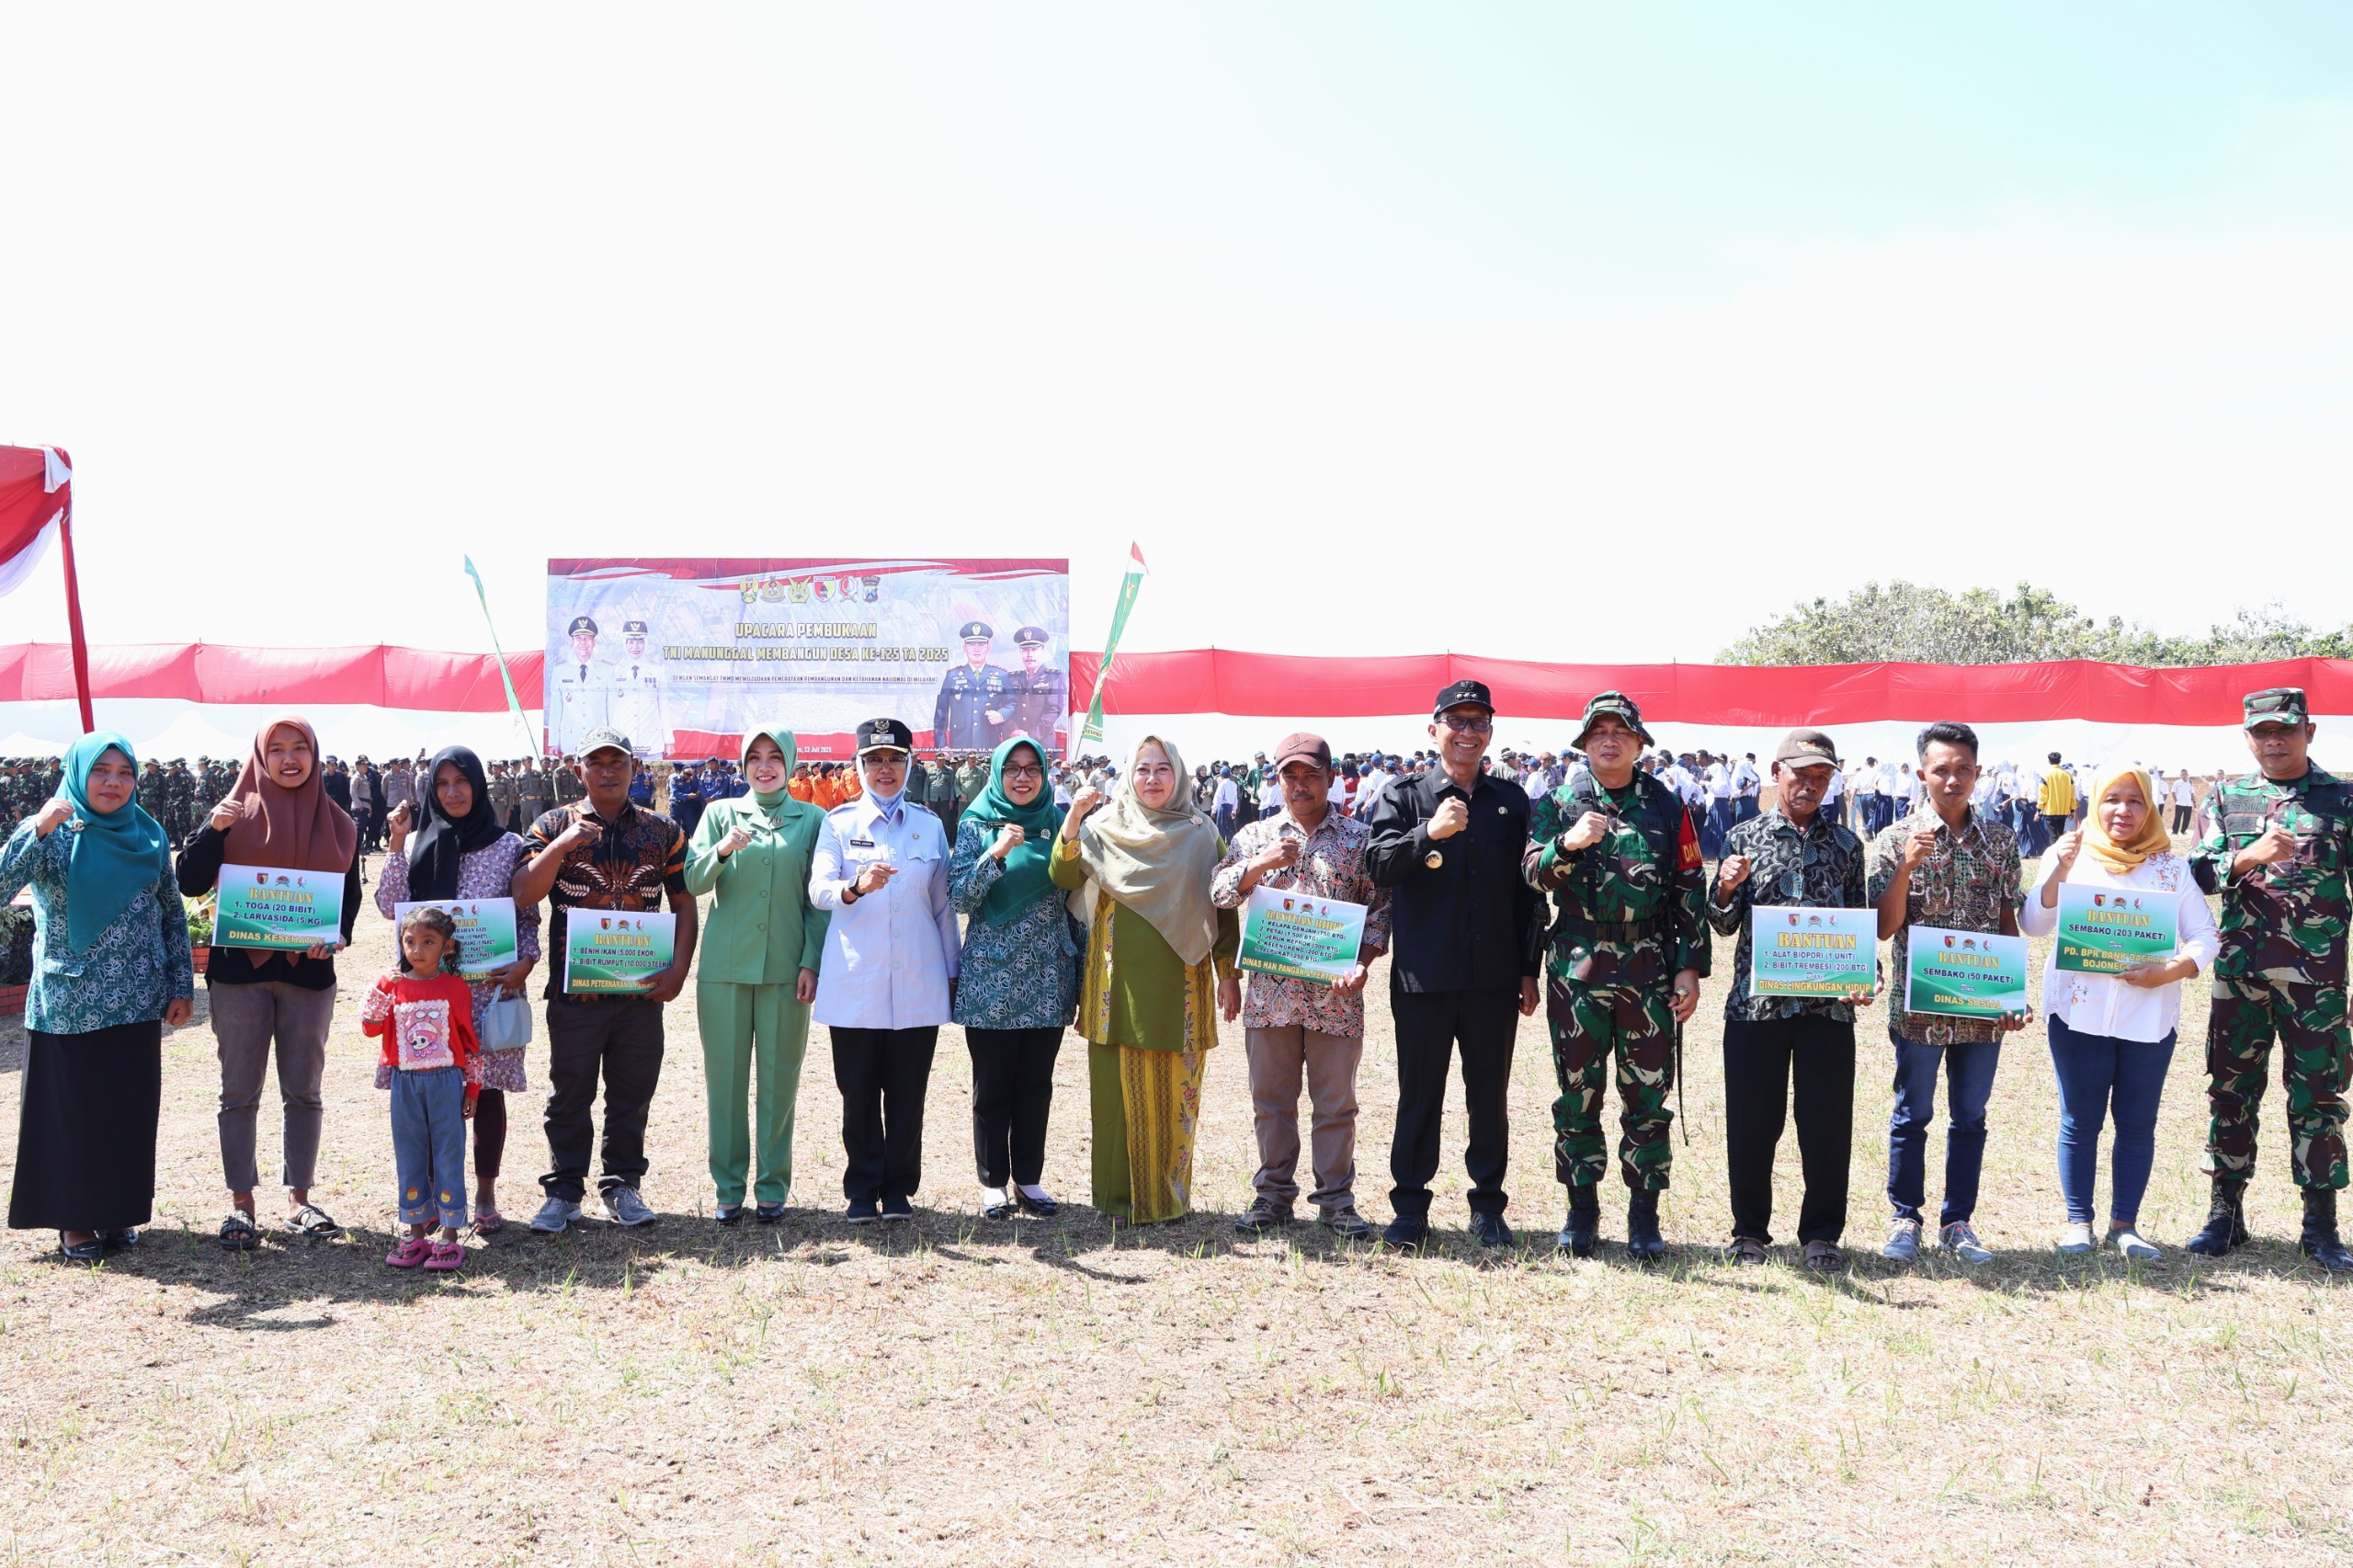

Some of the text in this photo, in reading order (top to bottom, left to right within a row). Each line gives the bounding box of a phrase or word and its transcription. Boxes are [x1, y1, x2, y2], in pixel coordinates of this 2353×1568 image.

[734, 623, 877, 638] UPACARA PEMBUKAAN
[663, 646, 949, 661] TNI MANUNGGAL MEMBANGUN DESA KE-125 TA 2025
[249, 888, 313, 903] BANTUAN
[289, 905, 315, 915] BIBIT)
[244, 913, 294, 923] LARVASIDA
[1266, 909, 1344, 932] BANTUAN BIBIT
[2087, 910, 2150, 927] BANTUAN
[229, 931, 261, 940] DINAS
[1268, 921, 1290, 929] KELAPA
[1292, 926, 1316, 934] GENJAH
[1332, 932, 1346, 940] BTG)
[1304, 934, 1318, 942] BTG)
[2069, 924, 2166, 941] SEMBAKO (203 PAKET)
[595, 934, 650, 947] BANTUAN
[1264, 941, 1304, 952] KELENGKENG
[1265, 934, 1285, 942] JERUK
[1287, 938, 1311, 947] KEPROK
[1326, 945, 1341, 953] BTG)
[1778, 932, 1857, 949] BANTUAN
[1263, 948, 1290, 957] ALPUKAT
[1938, 950, 1999, 969] BANTUAN
[2064, 947, 2167, 963] PD. BPR BANK DAERAH
[1242, 957, 1262, 968] DINAS
[1263, 961, 1277, 971] HAN
[1279, 963, 1303, 975] PANGAN
[1306, 968, 1311, 977] &
[1851, 964, 1870, 972] BTG)
[2083, 960, 2131, 970] BOJONEG
[573, 979, 589, 987] DINAS
[591, 980, 628, 988] PETERNAKAN
[1924, 968, 2014, 984] SEMBAKO (50 PAKET)
[1758, 980, 1871, 992] DINAS LINGKUNGAN HIDUP
[1934, 994, 2002, 1009] DINAS SOSIAL
